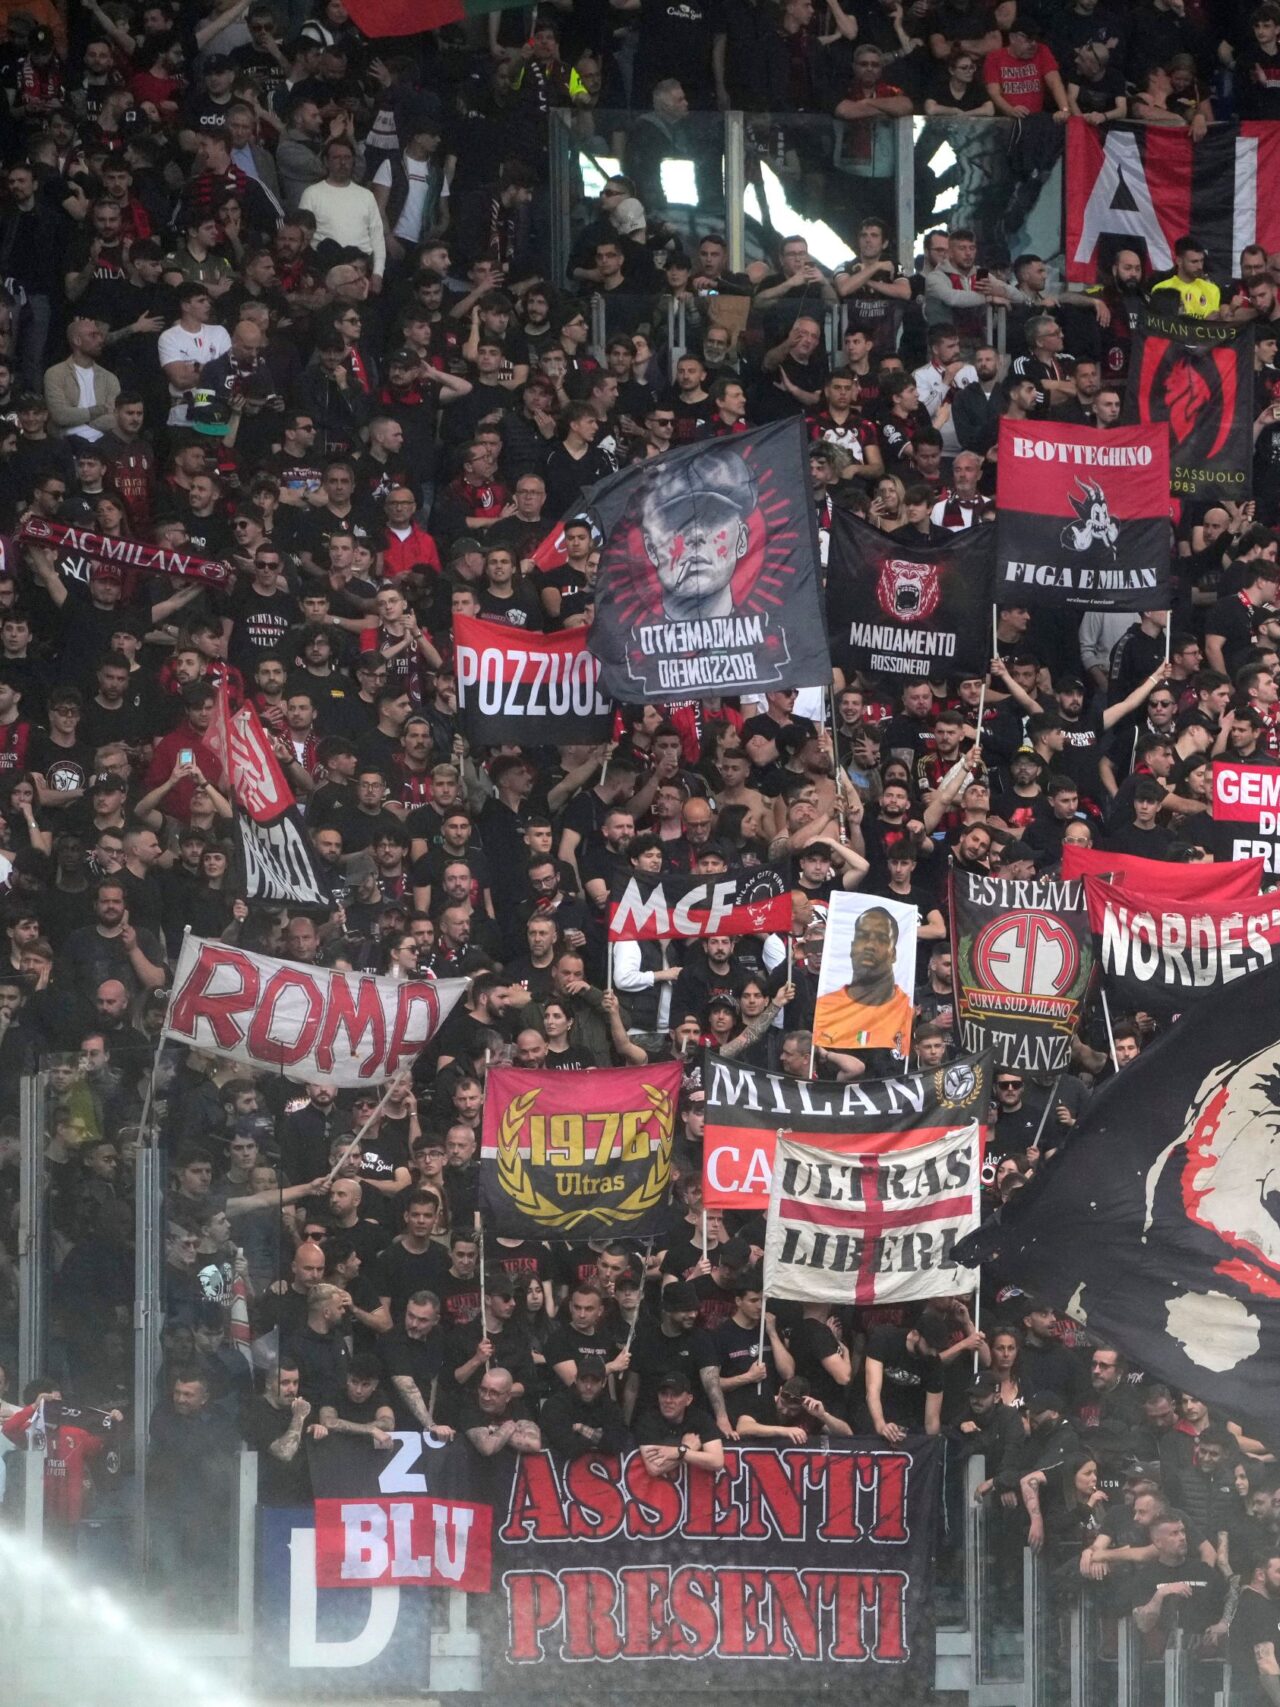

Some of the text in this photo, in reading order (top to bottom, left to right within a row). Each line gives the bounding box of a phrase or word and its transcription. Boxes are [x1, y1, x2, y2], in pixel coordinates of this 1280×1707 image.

[1147, 316, 1189, 337] MILAN
[1013, 437, 1153, 466] BOTTEGHINO
[1169, 480, 1196, 494] 1983
[1174, 466, 1245, 483] SASSUOLO
[59, 527, 192, 574] AC MILAN
[1005, 561, 1157, 589] FIGA E MILAN
[849, 622, 956, 657] MANDAMENTO
[870, 654, 930, 676] ROSSONERO
[610, 876, 737, 935] MCF
[968, 992, 1071, 1018] CURVA SUD MILANO
[707, 1060, 925, 1116] MILAN
[530, 1109, 654, 1167] 1976
[555, 1172, 625, 1197] Ultras
[782, 1145, 973, 1201] ULTRAS
[778, 1228, 960, 1274] LIBERI
[499, 1448, 914, 1545] ASSENTI
[339, 1502, 474, 1582] BLU
[501, 1564, 911, 1665] PRESENTI
